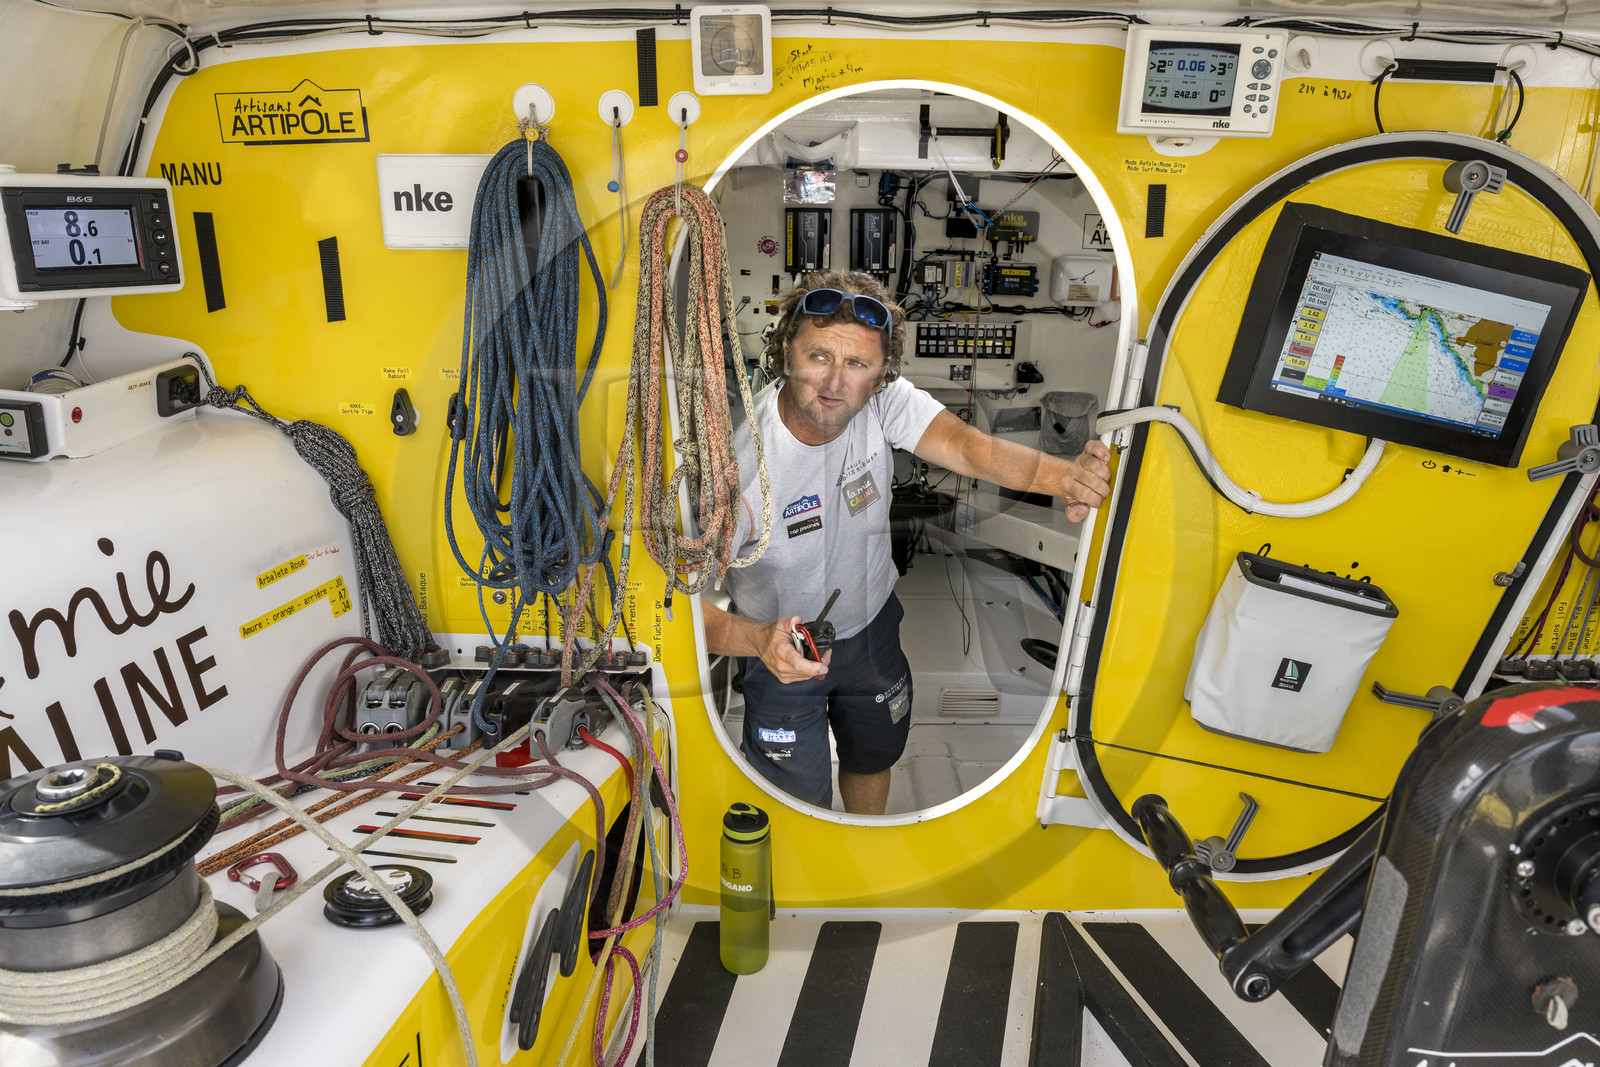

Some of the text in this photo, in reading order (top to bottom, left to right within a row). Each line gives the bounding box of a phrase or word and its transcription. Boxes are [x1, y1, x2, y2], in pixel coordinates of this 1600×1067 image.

[1177, 60, 1206, 72] 0.06
[1148, 86, 1168, 97] 7.3
[234, 98, 291, 114] Artisans
[1212, 119, 1230, 129] nke
[160, 162, 222, 186] MANU
[393, 184, 453, 212] nke
[64, 211, 98, 237] 8.6
[69, 239, 101, 265] 0.1
[258, 558, 306, 587] Arbalete Rose
[342, 600, 351, 612] J4
[242, 621, 263, 637] Amure
[272, 605, 296, 621] orange
[653, 600, 662, 662] Down Fucker gv
[1550, 602, 1567, 650] Foil sortie
